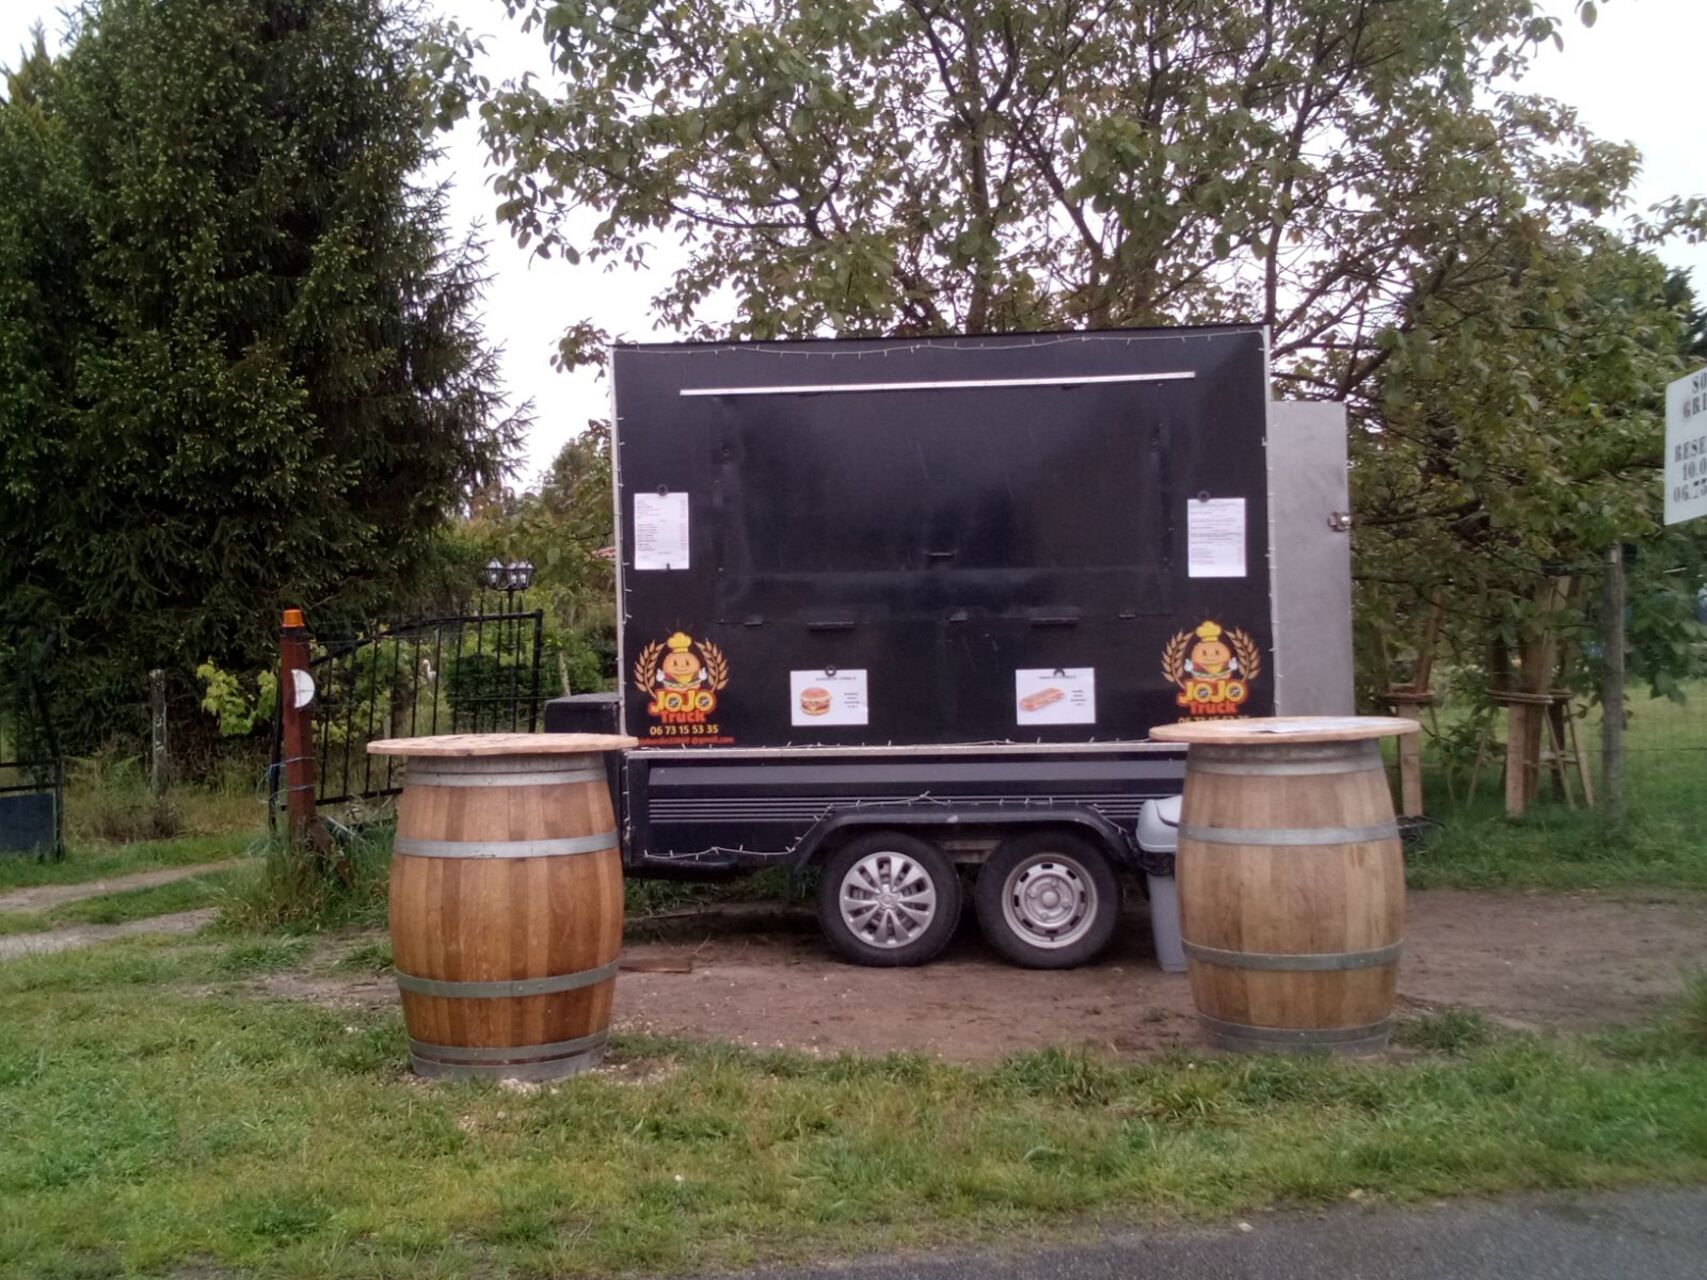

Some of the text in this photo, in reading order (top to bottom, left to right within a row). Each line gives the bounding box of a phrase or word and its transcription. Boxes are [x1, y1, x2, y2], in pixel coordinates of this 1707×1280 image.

[1190, 701, 1238, 715] Truck
[661, 710, 706, 723] Truck
[649, 724, 719, 736] 06 73 15 53 35
